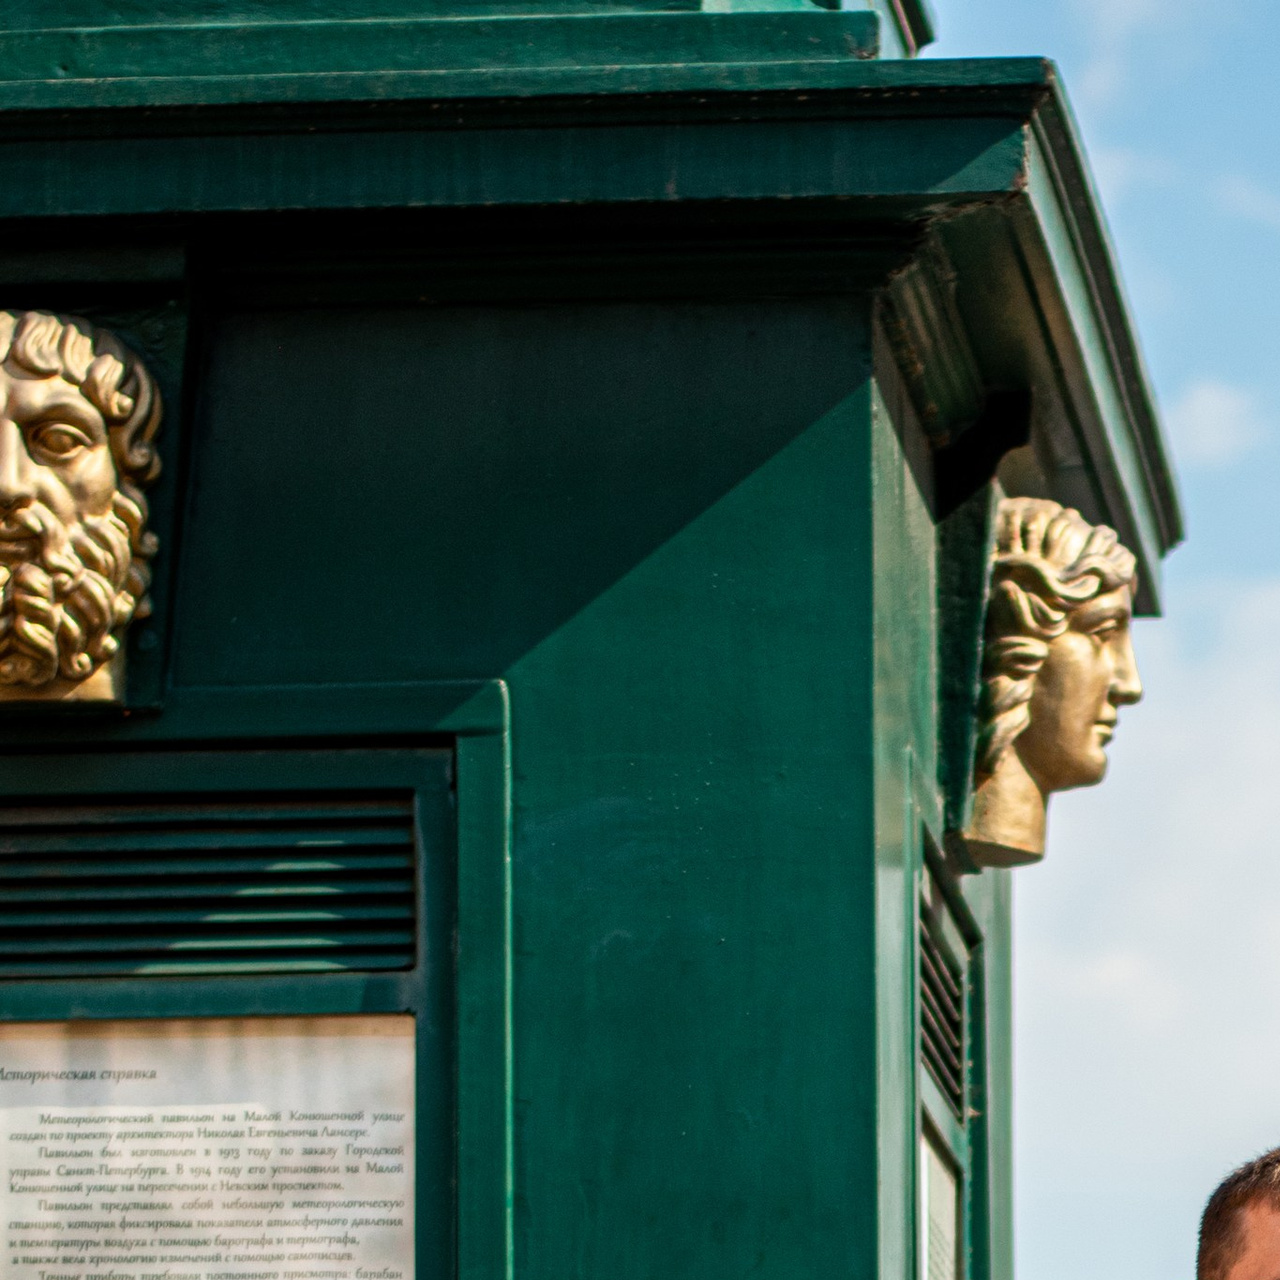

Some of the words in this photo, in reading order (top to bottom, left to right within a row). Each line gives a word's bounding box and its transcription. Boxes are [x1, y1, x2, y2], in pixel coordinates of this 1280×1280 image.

[100, 1069, 156, 1083] справка
[39, 1113, 153, 1126] Метеорологический
[162, 1114, 214, 1122] павильон
[222, 1114, 236, 1122] на
[244, 1110, 281, 1121] Малой
[290, 1110, 364, 1121] Конюшенной
[50, 1132, 64, 1140] по
[66, 1132, 113, 1143] проекту
[116, 1131, 194, 1142] архитектора
[197, 1128, 245, 1138] Николая
[248, 1126, 318, 1138] Евгеньевича
[38, 1146, 93, 1158] Павильон
[100, 1146, 122, 1158] был
[130, 1148, 196, 1158] изготовлен
[218, 1148, 240, 1159] 1913
[248, 1148, 272, 1160] году
[280, 1148, 294, 1156] по
[302, 1147, 338, 1160] заказу
[346, 1144, 404, 1158] Городской
[9, 1167, 50, 1180] управы
[190, 1167, 211, 1177] 1914
[218, 1166, 242, 1178] году
[248, 1166, 266, 1174] его
[271, 1165, 340, 1178] установили
[346, 1164, 360, 1174] на
[366, 1162, 404, 1173] Малой
[9, 1182, 83, 1193] Конюшенной
[86, 1183, 118, 1196] улице
[121, 1184, 134, 1192] на
[138, 1182, 208, 1196] пересечении
[220, 1180, 269, 1191] Невским
[272, 1182, 344, 1194] проспектом.
[38, 1200, 92, 1211] Павильон
[181, 1197, 214, 1210] собой
[222, 1197, 284, 1212] небольшую
[292, 1200, 404, 1212] метеорологическую
[8, 1220, 64, 1232] станцию,
[68, 1220, 115, 1232] которая
[120, 1216, 192, 1232] фиксировала
[197, 1219, 262, 1228] показатели
[266, 1214, 348, 1230] атмосферного
[351, 1218, 403, 1229] давления
[20, 1238, 100, 1251] температуры
[104, 1238, 146, 1251] воздуха
[159, 1238, 212, 1248] помощью
[214, 1233, 273, 1249] барографа
[286, 1232, 360, 1248] термографа,
[89, 1254, 157, 1268] хронологию
[160, 1252, 222, 1264] изменений
[234, 1253, 285, 1264] помощью
[206, 1271, 279, 1280] постоянного
